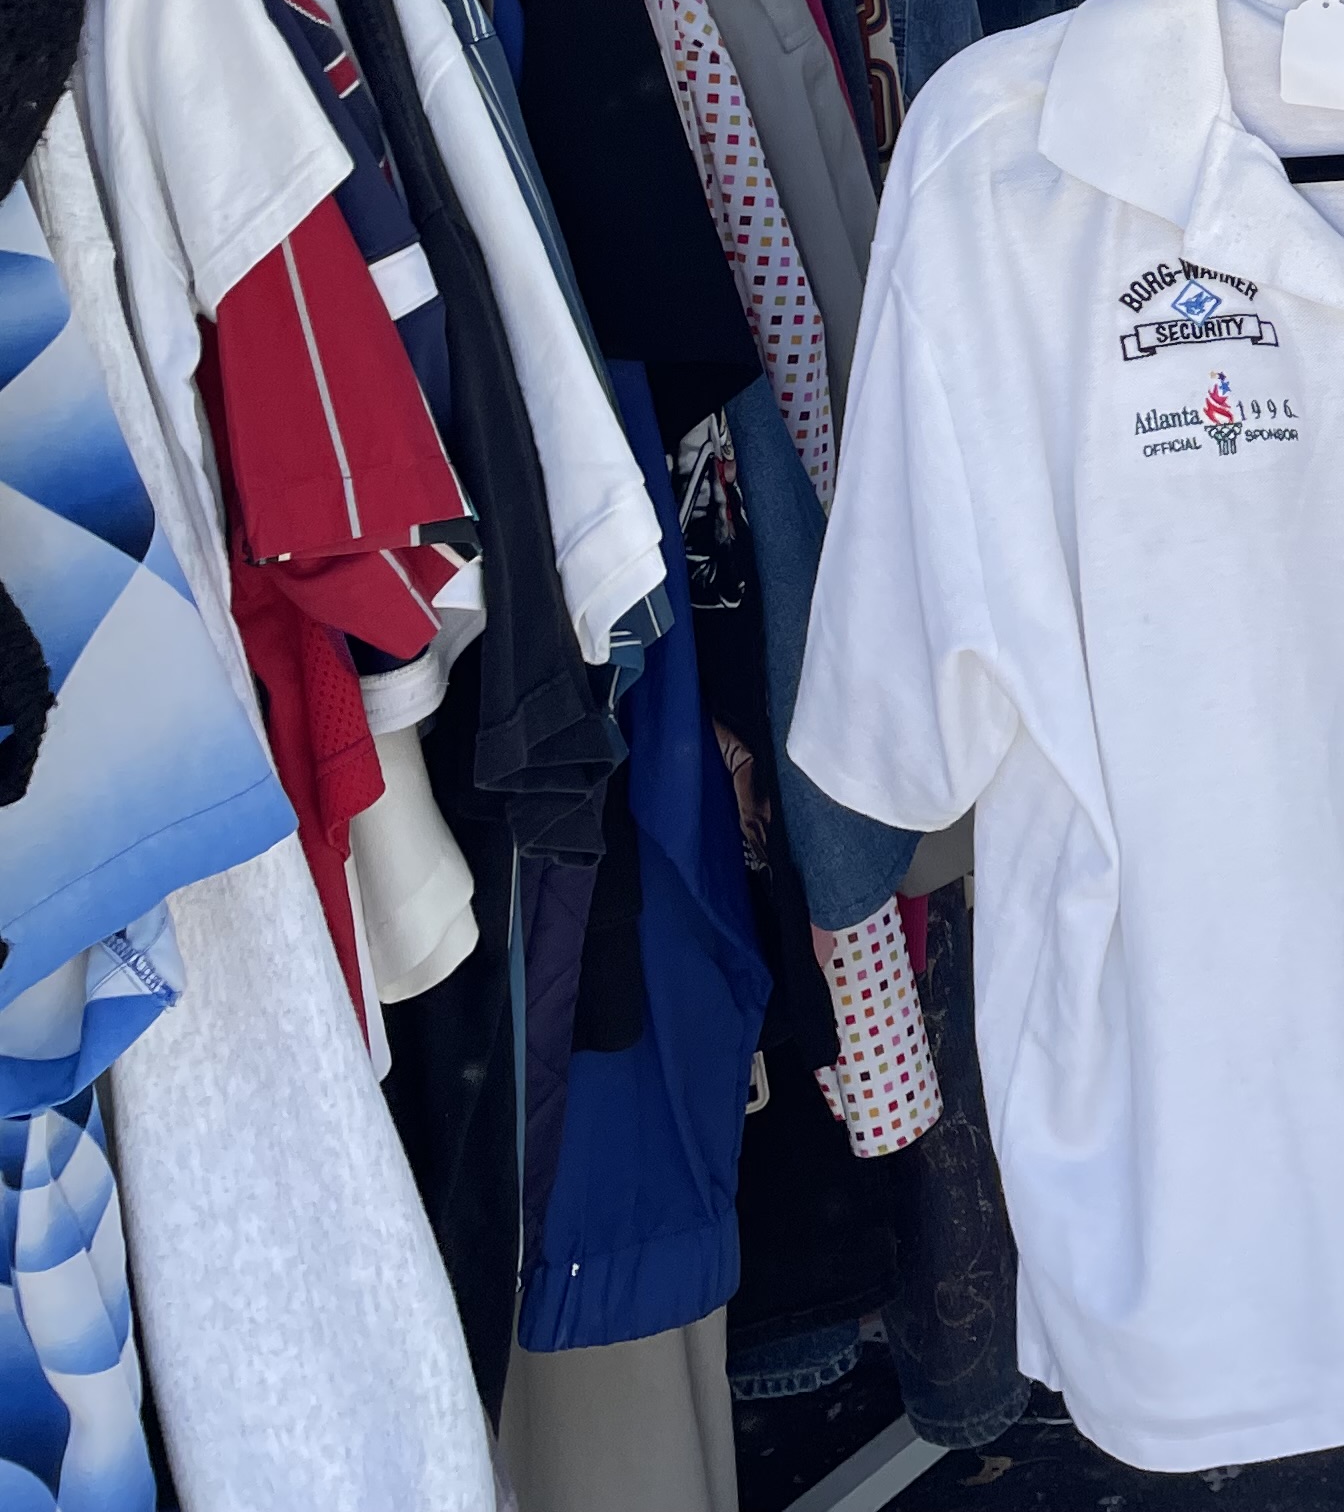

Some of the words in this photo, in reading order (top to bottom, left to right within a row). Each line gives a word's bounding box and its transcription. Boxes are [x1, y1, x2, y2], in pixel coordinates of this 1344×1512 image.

[1155, 317, 1244, 343] SECURITY
[1135, 406, 1203, 435] Atlanta
[1236, 398, 1299, 421] 1996
[1143, 437, 1202, 458] OFFICIAL
[1244, 428, 1299, 443] SPONSOR
